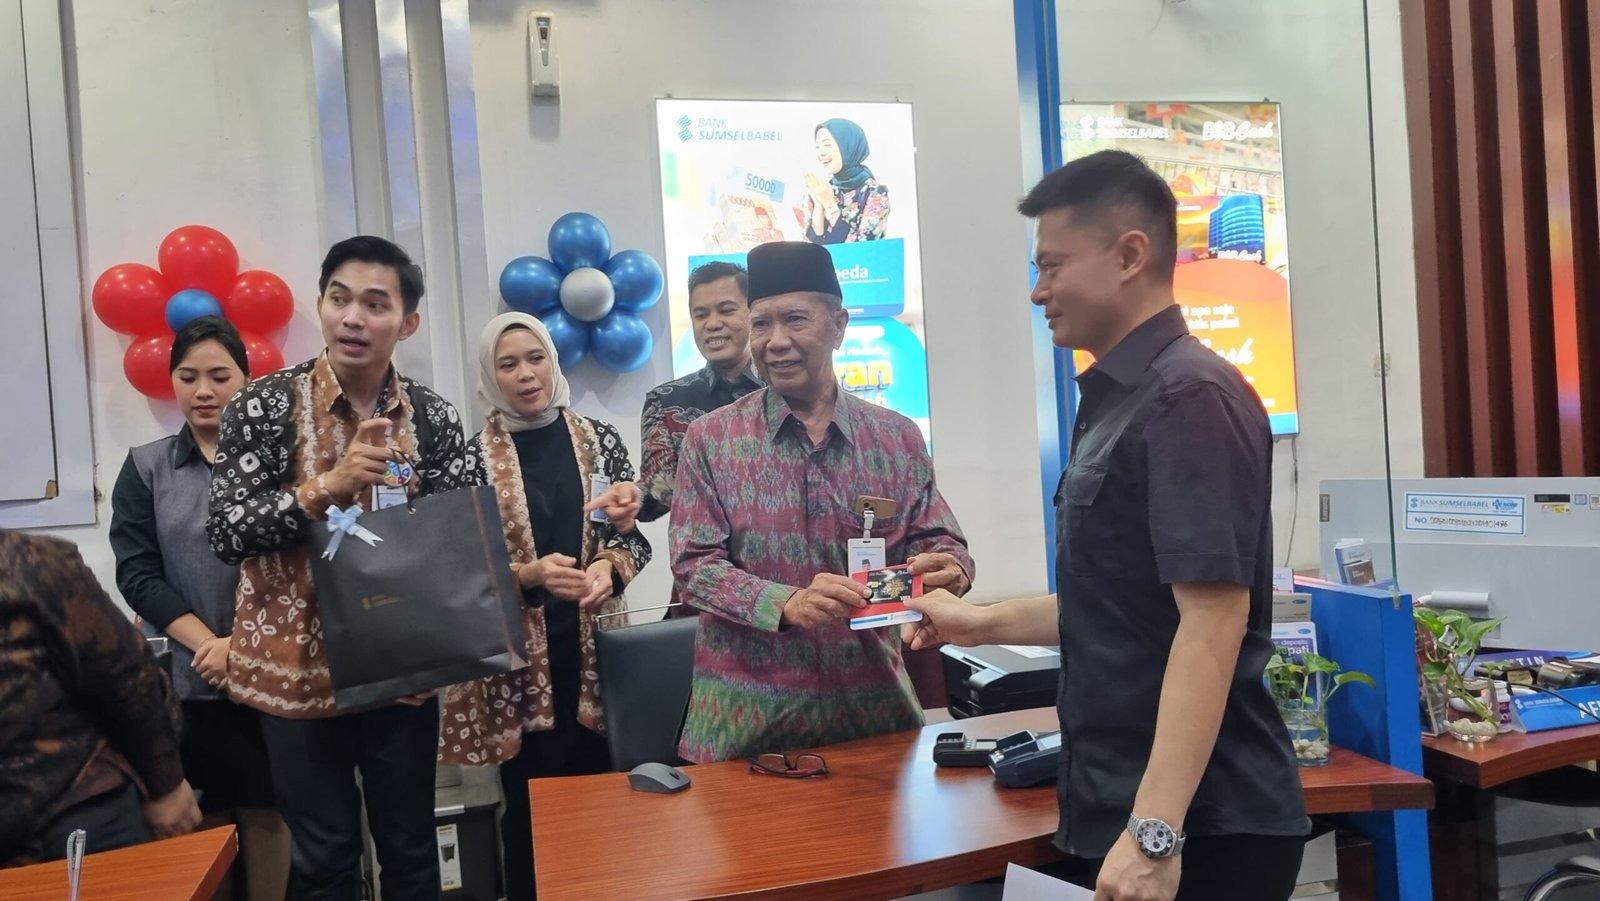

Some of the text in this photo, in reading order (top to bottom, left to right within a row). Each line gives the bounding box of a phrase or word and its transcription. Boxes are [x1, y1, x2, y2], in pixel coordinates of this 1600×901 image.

[698, 117, 728, 128] BANK
[698, 129, 783, 142] SUMSELBABEL
[744, 173, 776, 194] 50000
